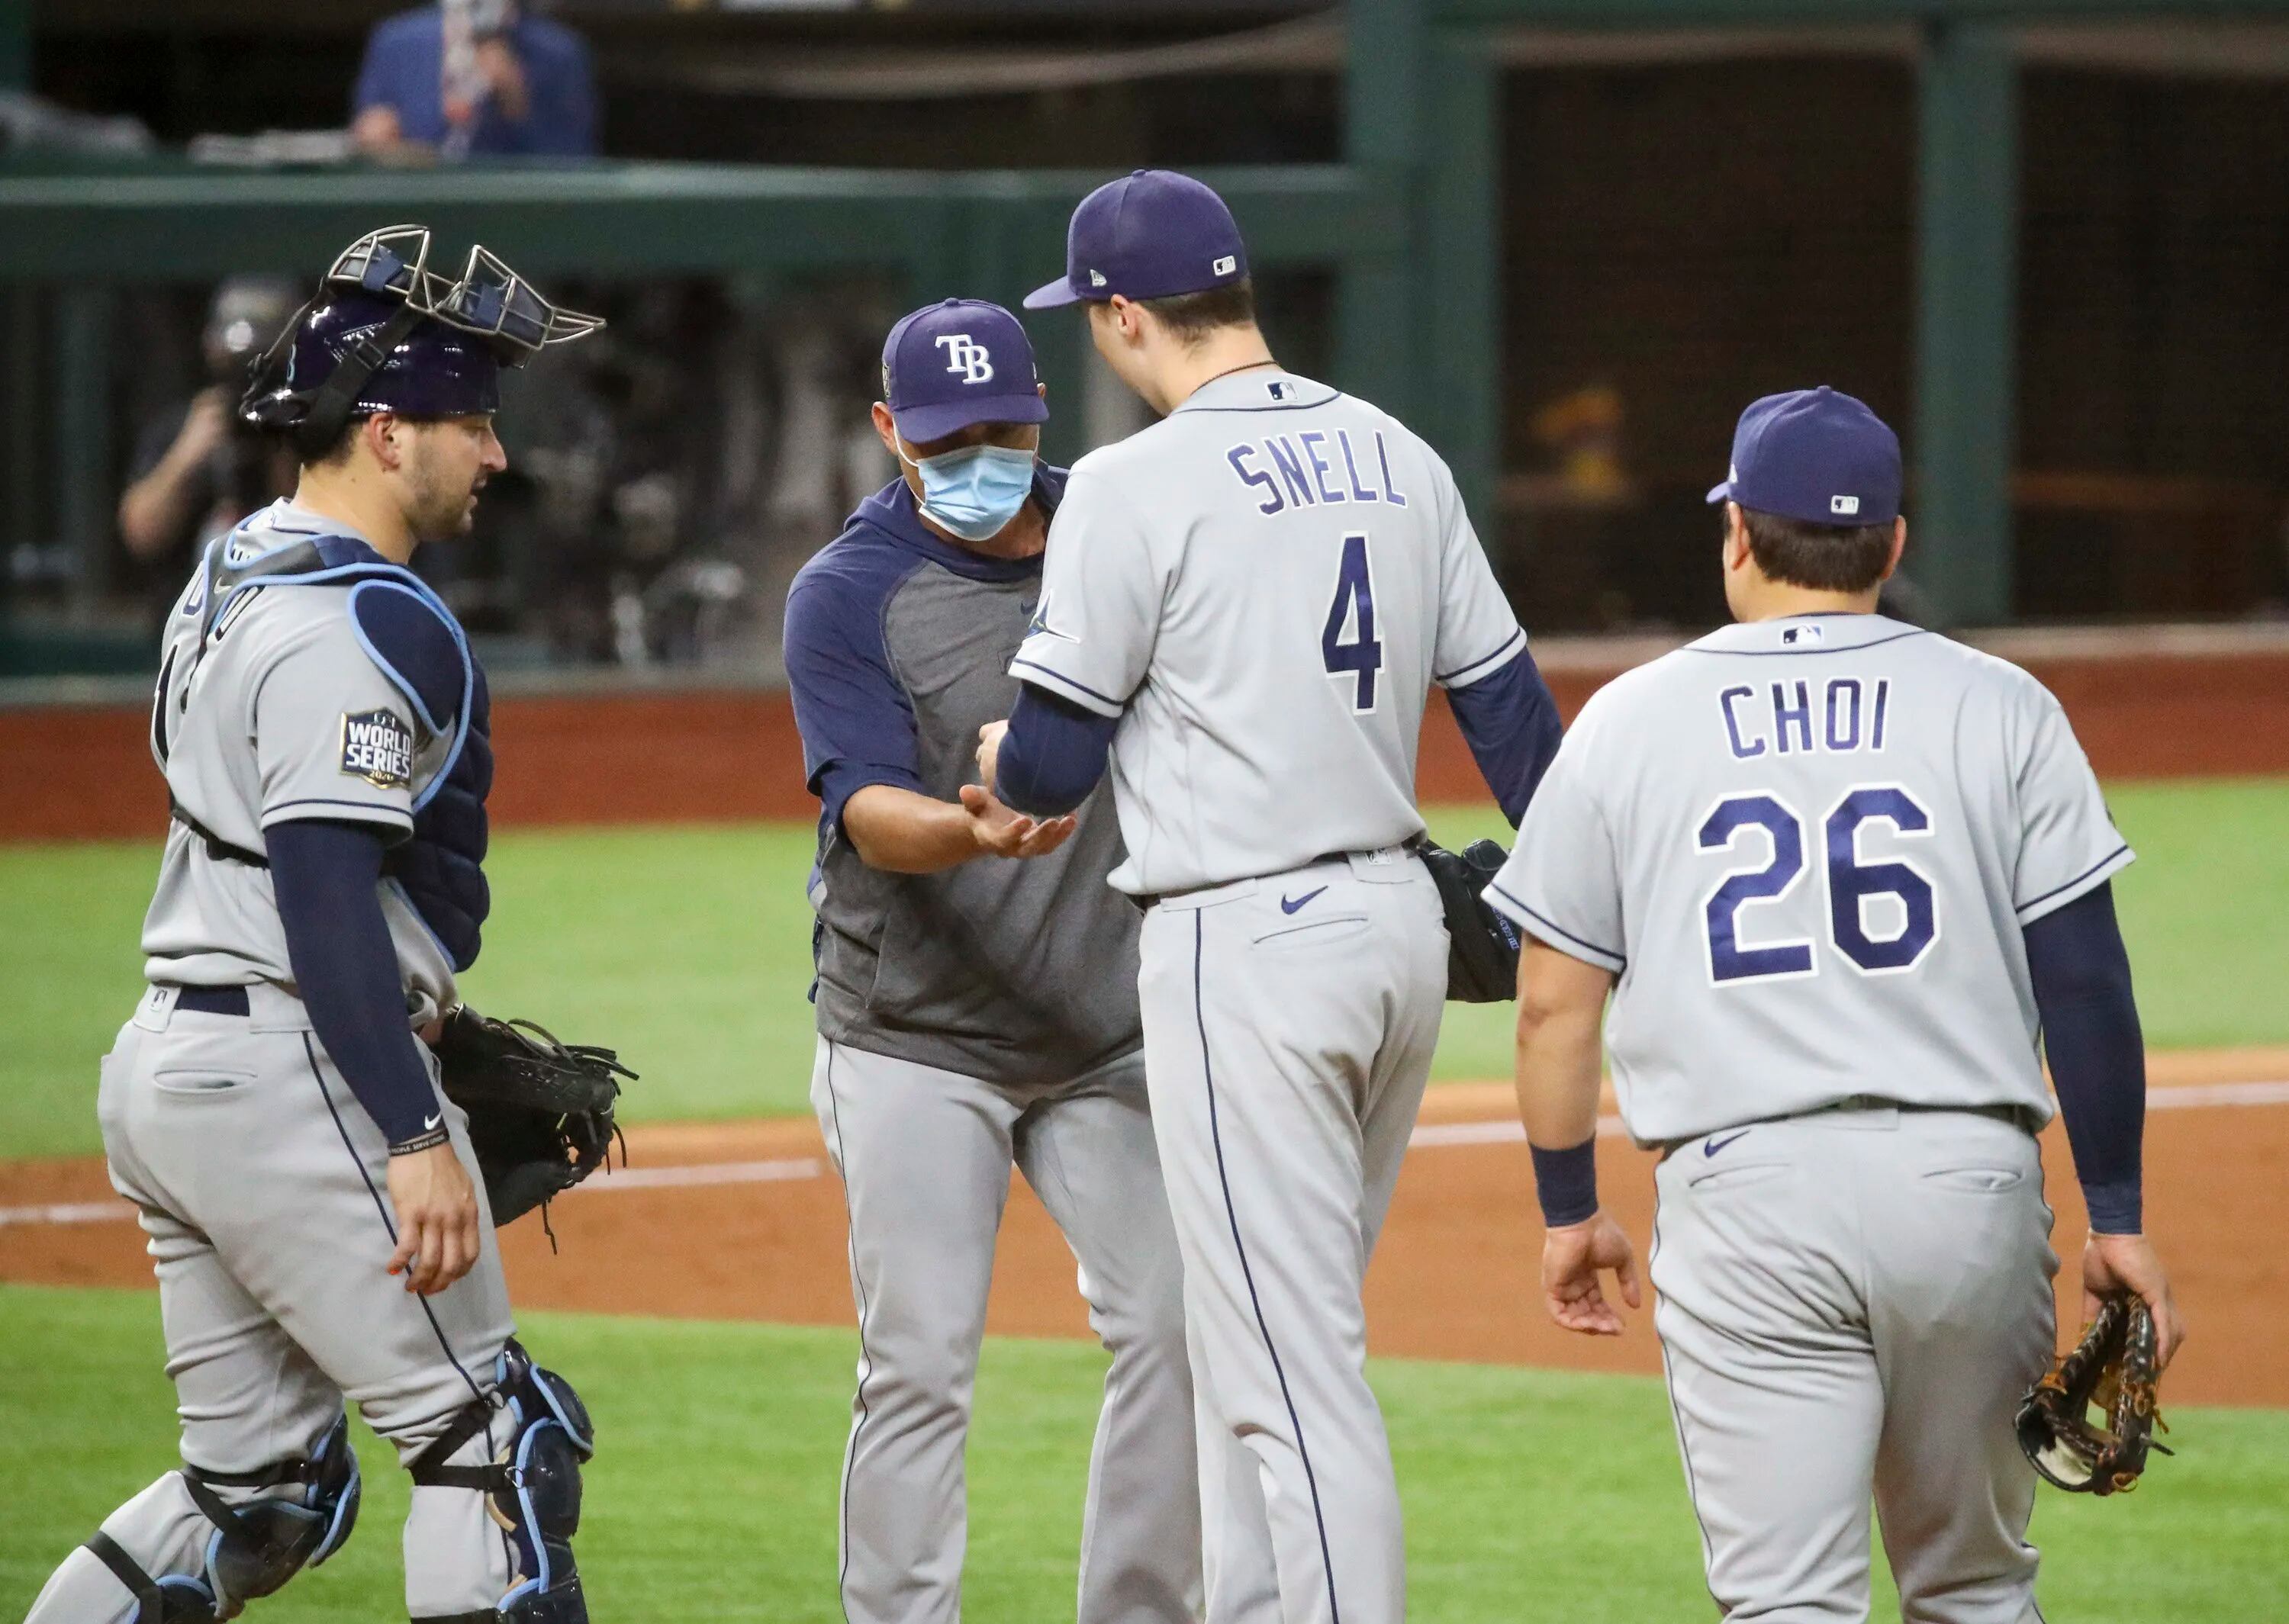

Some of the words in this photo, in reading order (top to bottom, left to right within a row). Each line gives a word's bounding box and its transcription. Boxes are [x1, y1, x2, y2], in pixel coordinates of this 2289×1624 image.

[935, 334, 994, 384] TB
[1224, 427, 1408, 516] SNELL
[1321, 530, 1386, 716] 4
[346, 743, 410, 779] SERIES
[348, 722, 410, 757] WORLD
[1718, 677, 1891, 762] CHOI
[1693, 780, 1942, 989] 26
